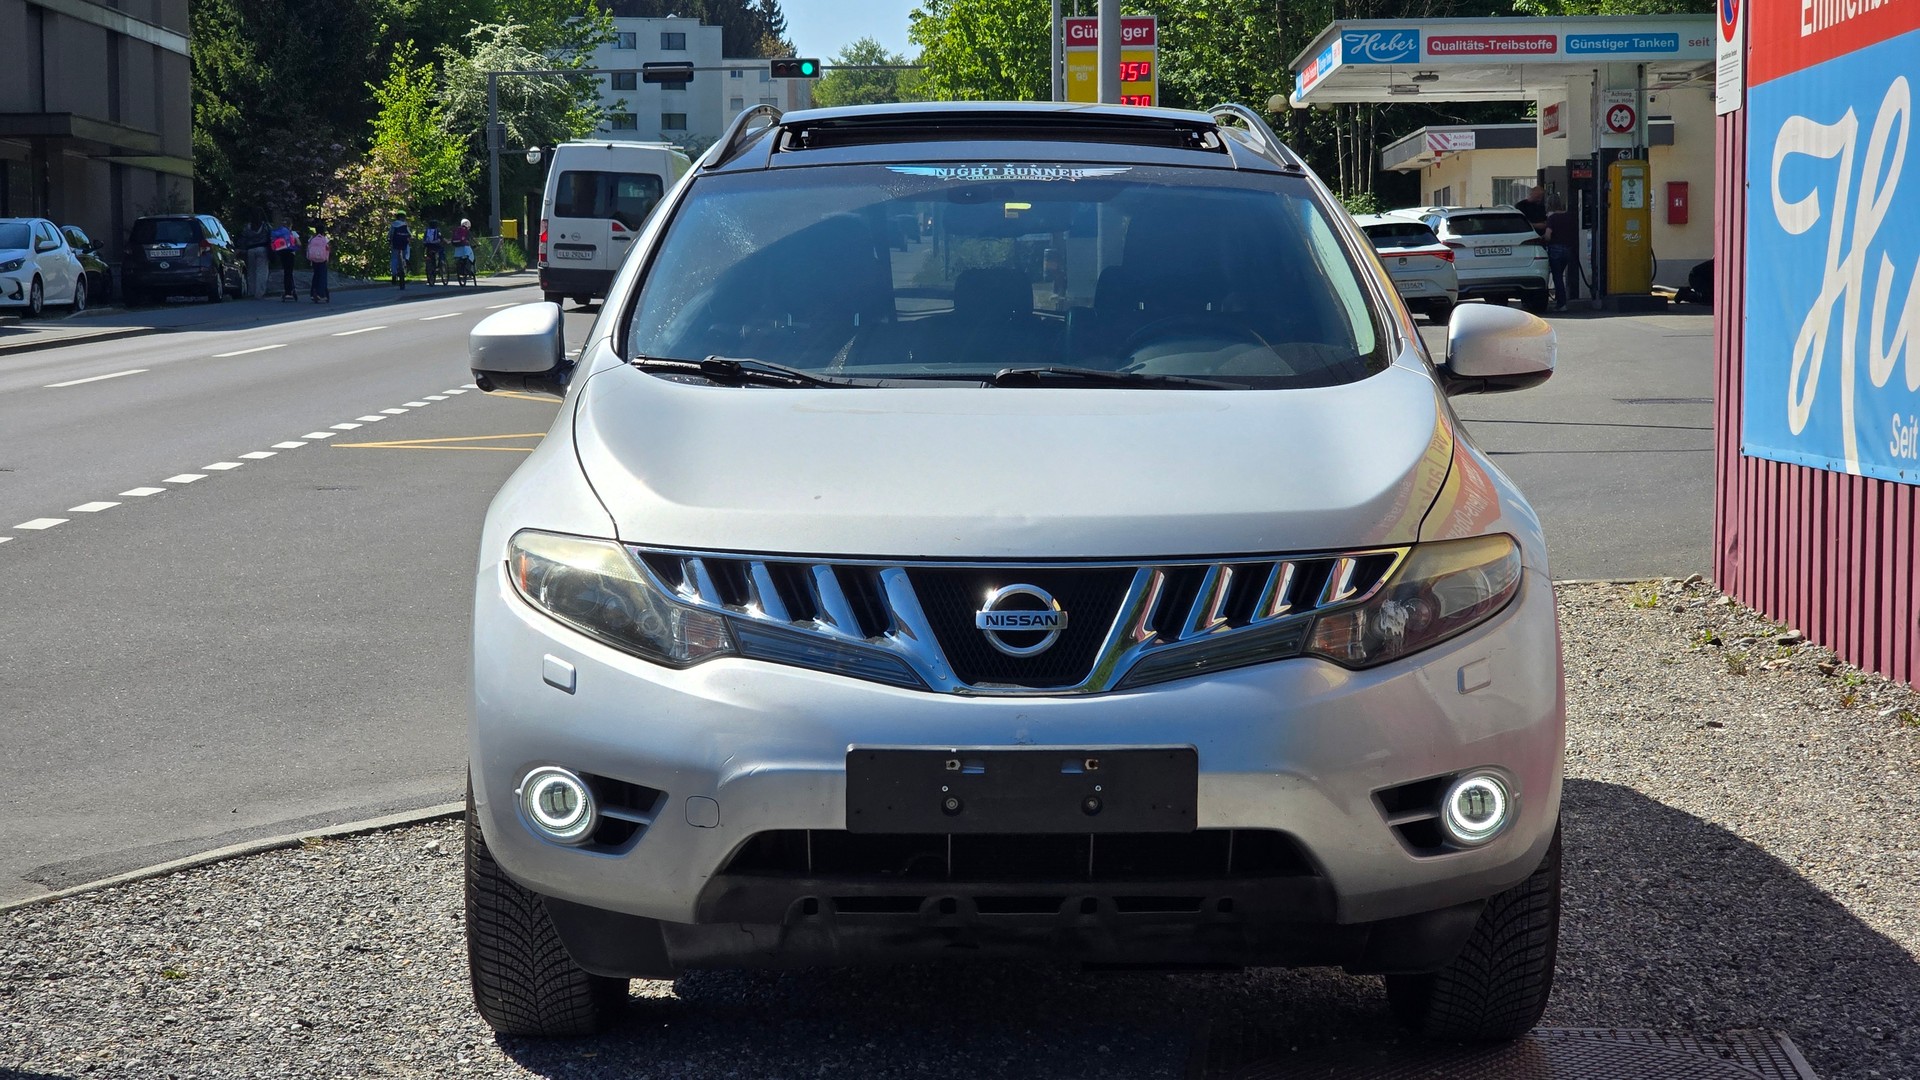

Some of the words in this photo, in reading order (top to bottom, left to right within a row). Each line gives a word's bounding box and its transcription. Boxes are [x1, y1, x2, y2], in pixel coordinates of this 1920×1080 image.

[1343, 32, 1417, 62] Huber
[1431, 39, 1553, 52] Qualitäts-Treibstoffe
[1570, 38, 1629, 50] Günstiger
[1632, 37, 1675, 48] Tanken
[1688, 36, 1710, 47] seit
[933, 167, 997, 177] NIGHT
[1002, 167, 1084, 177] RUNNER
[1890, 412, 1919, 460] Seit
[985, 614, 1059, 626] NISSAN
